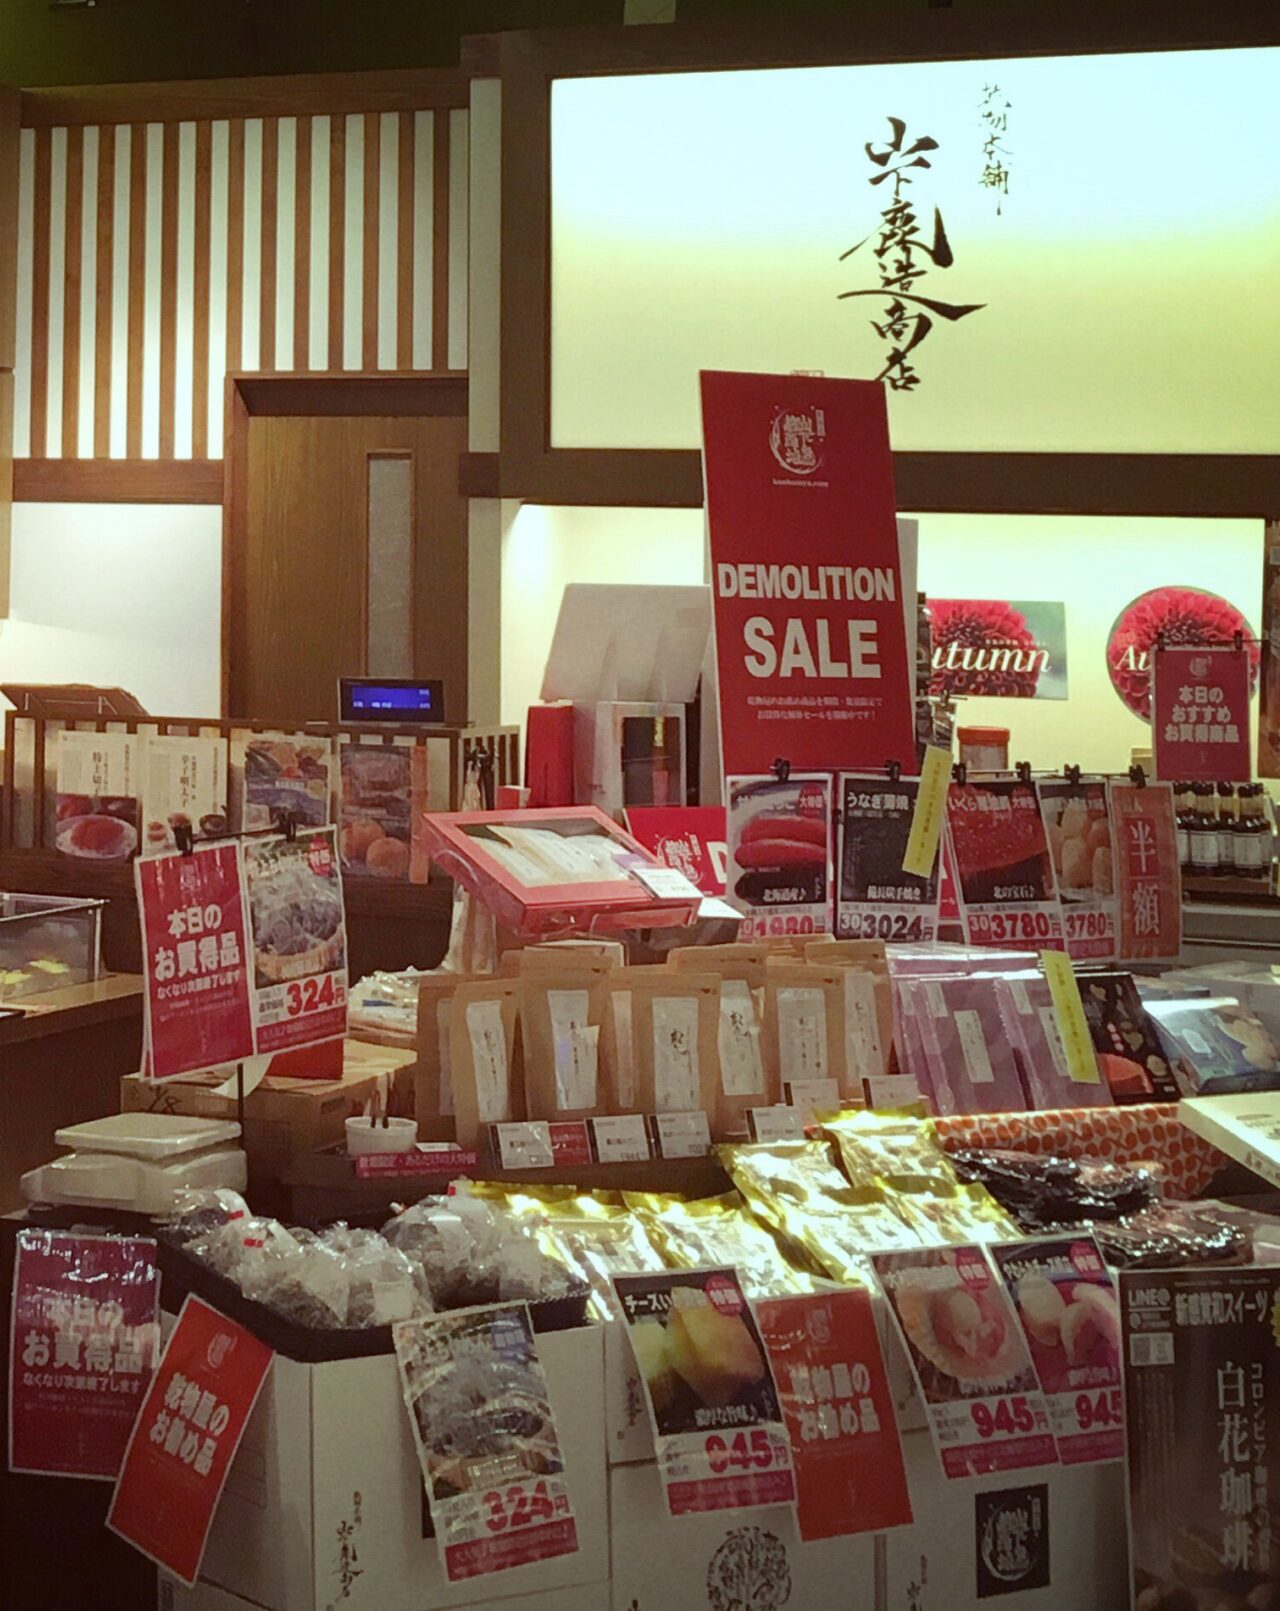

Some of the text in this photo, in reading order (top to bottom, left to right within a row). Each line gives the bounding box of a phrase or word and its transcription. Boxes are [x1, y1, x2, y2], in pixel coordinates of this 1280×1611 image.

[717, 563, 894, 601] DEMOLITION
[743, 616, 881, 678] SALE
[931, 640, 1052, 672] utumn
[1172, 704, 1231, 722] おすすめ
[1179, 684, 1224, 703] 本日の
[1130, 820, 1161, 935] 半額
[168, 904, 222, 939] 本日の
[863, 914, 923, 940] 3024
[991, 912, 1050, 939] 3780
[1066, 912, 1107, 937] 3780
[155, 931, 241, 982] お買得品
[287, 974, 335, 1016] 324
[22, 1327, 144, 1374] お買得品
[971, 1396, 1035, 1438] 945
[1075, 1390, 1122, 1430] 945
[705, 1430, 773, 1473] 945
[482, 1480, 554, 1531] 324
